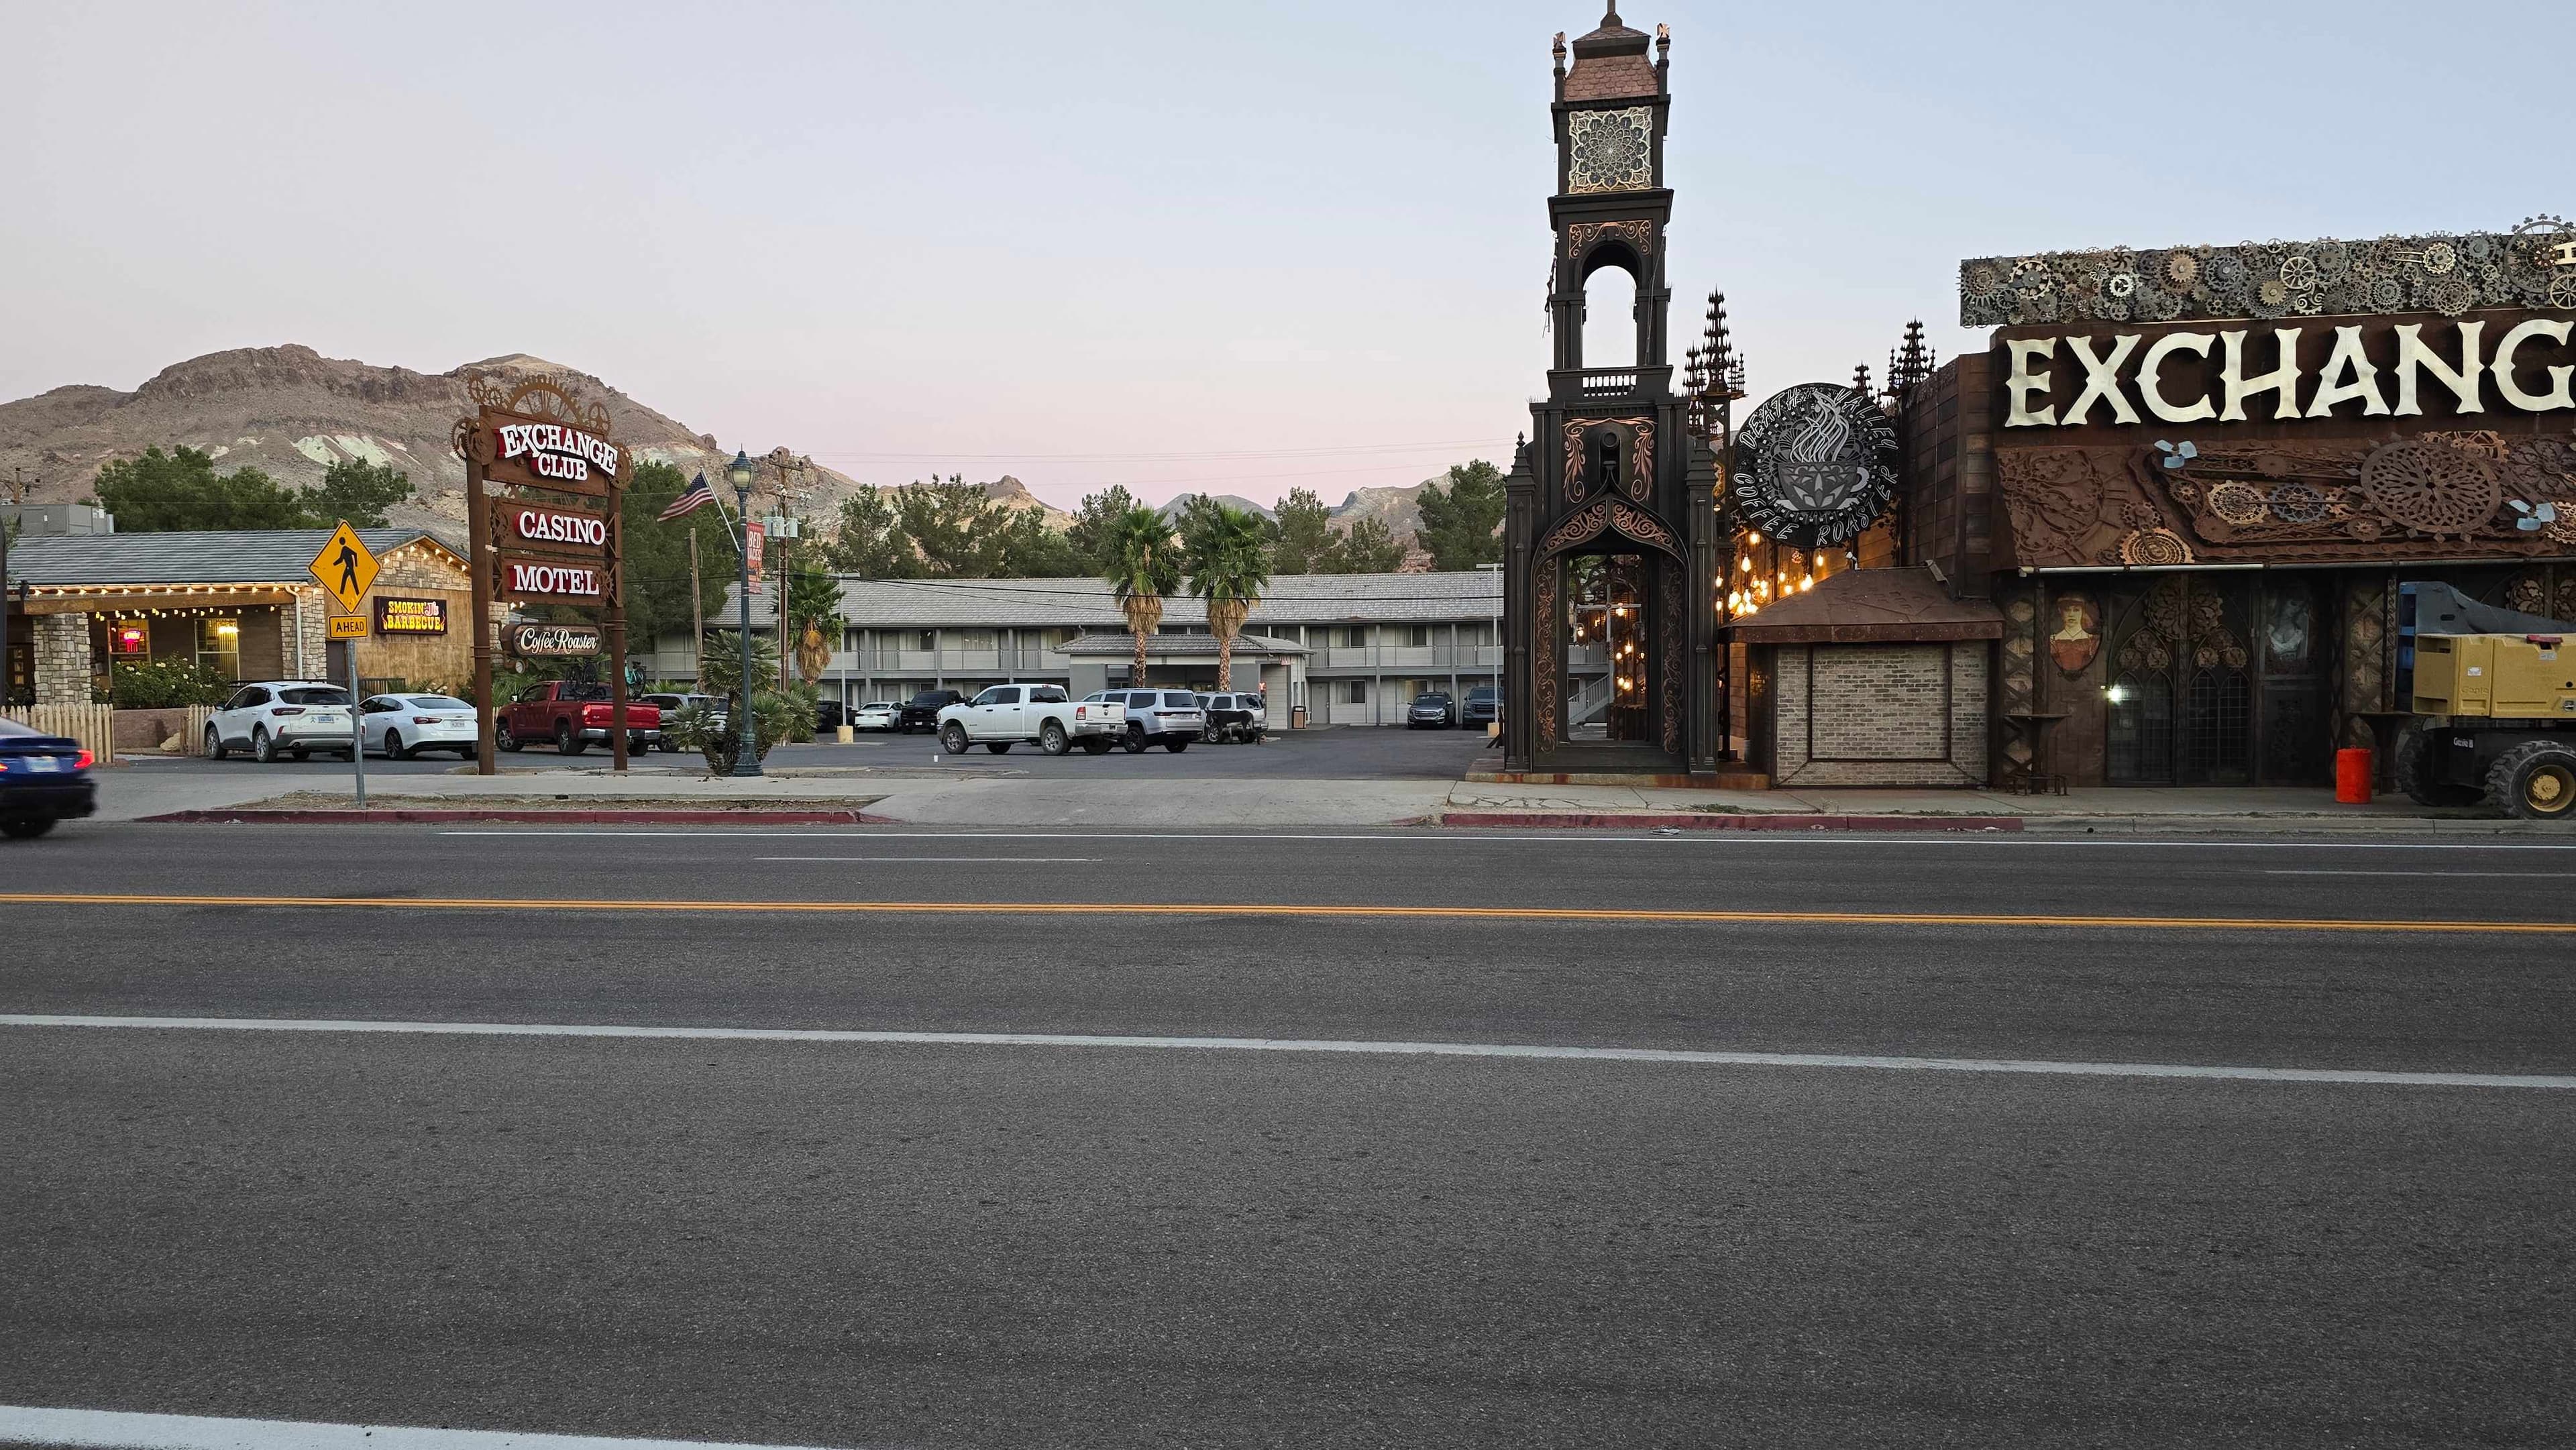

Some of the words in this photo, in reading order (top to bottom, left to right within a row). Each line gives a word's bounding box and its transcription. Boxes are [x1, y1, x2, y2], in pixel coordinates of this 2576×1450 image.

[2004, 319, 2575, 427] EXCHANG
[1739, 388, 1799, 449] DEATH
[1834, 388, 1899, 449] VALLEY
[500, 424, 618, 476] EXCHANGE
[538, 453, 588, 481] CLUB
[1733, 473, 1799, 539] COFFEE
[1817, 465, 1898, 546] ROASTER
[519, 511, 606, 545] CASINO
[749, 531, 761, 548] BED
[514, 565, 600, 595] MOTEL
[388, 601, 427, 614] SMOKIN'
[336, 621, 364, 632] AHEAD
[387, 614, 441, 630] BARBECUE
[521, 627, 555, 654] Coffee
[553, 628, 597, 654] Roaster
[2461, 686, 2489, 695] Genie
